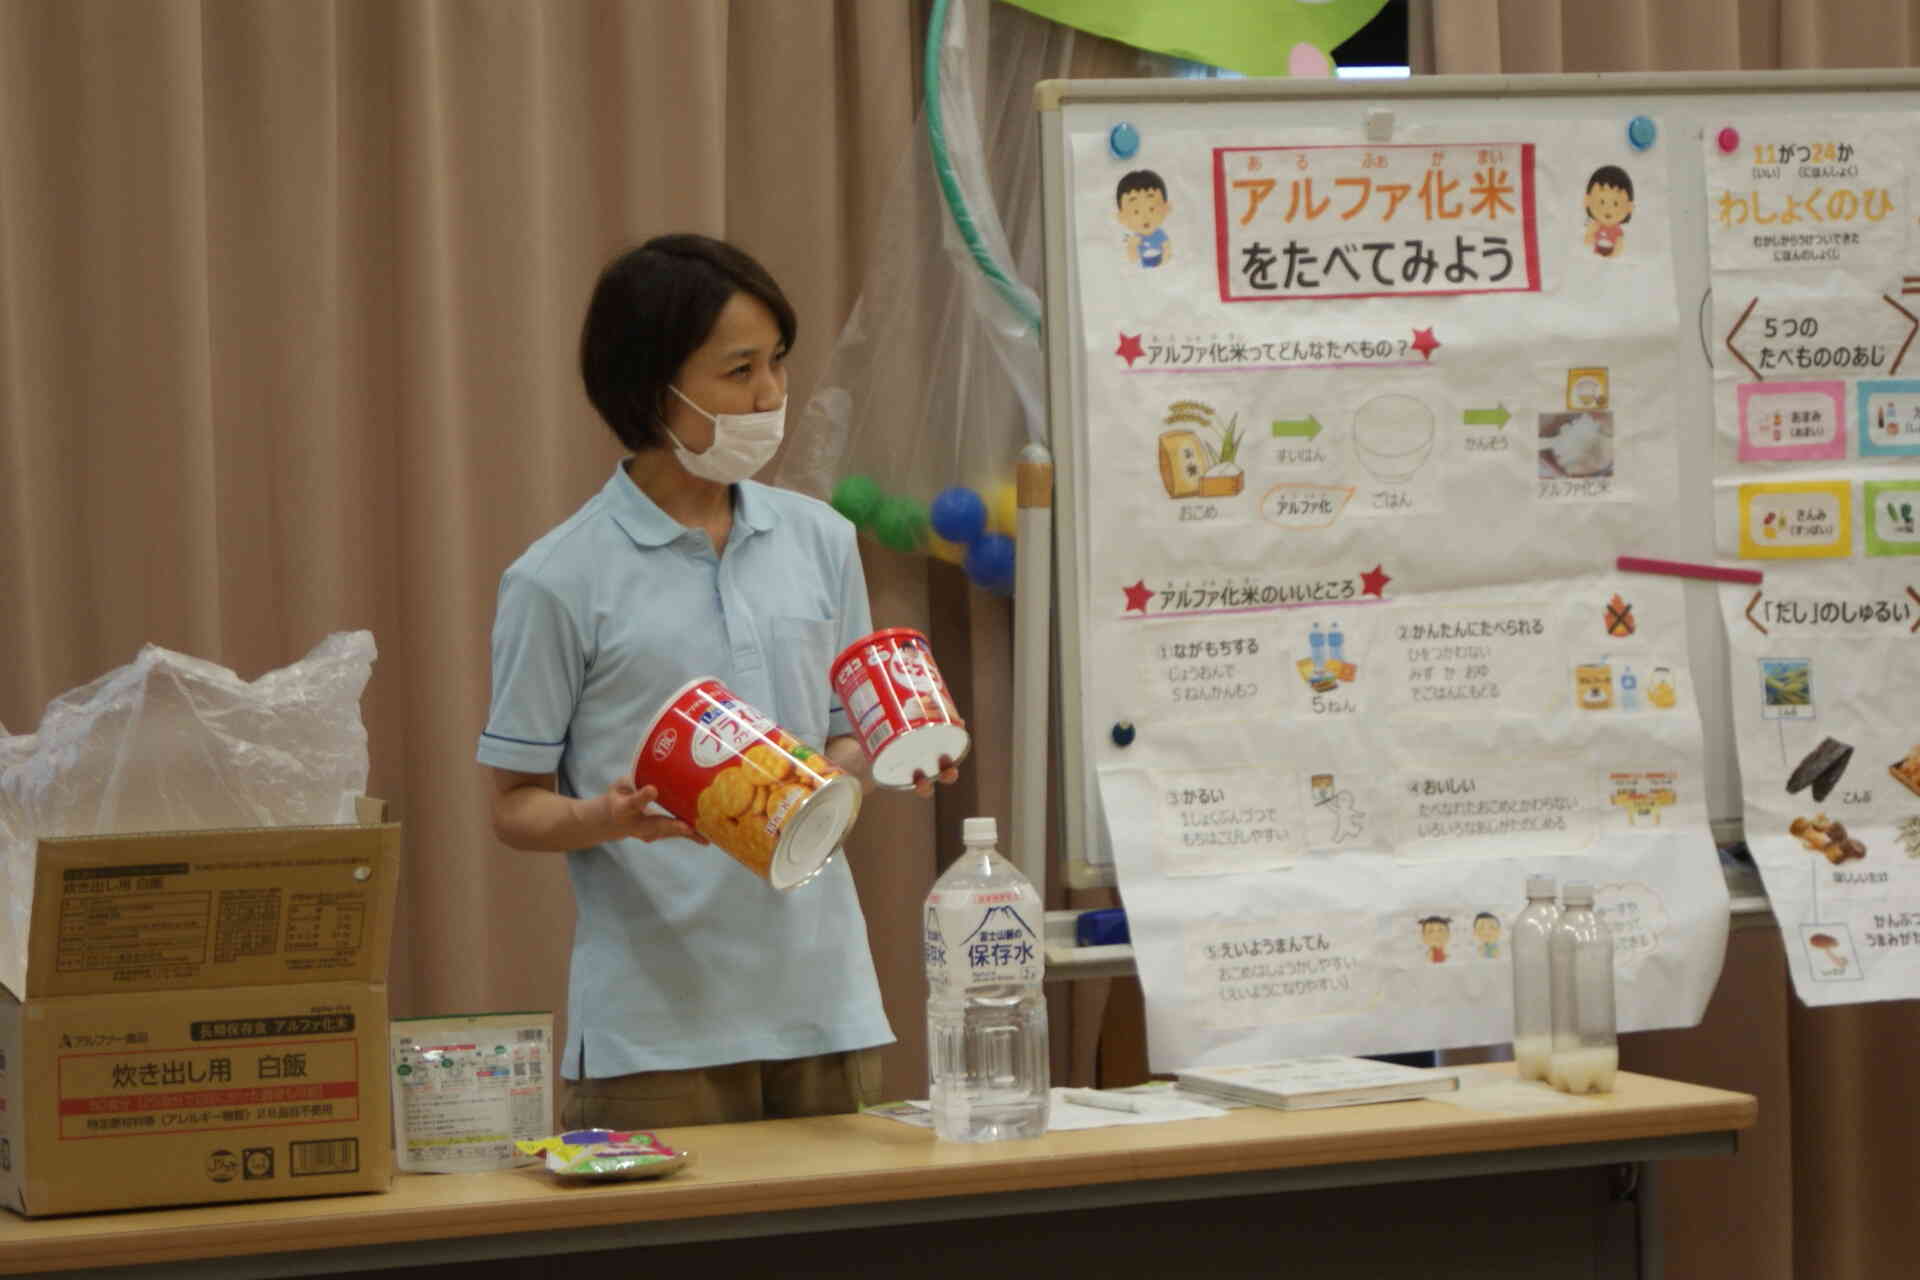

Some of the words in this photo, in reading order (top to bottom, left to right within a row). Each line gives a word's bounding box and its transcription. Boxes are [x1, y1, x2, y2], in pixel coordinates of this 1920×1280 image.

[1232, 166, 1515, 226] アルファ化米
[1719, 187, 1897, 228] わしょくのひ
[1241, 236, 1514, 291] をたべてみよう
[1764, 317, 1818, 338] 5つの
[1759, 345, 1885, 369] たべもののあじ
[1160, 580, 1355, 609] アルファ化米のいいところ
[968, 941, 1035, 968] 保存水
[112, 1057, 232, 1089] 炊き出し用
[258, 1053, 307, 1080] 白飯
